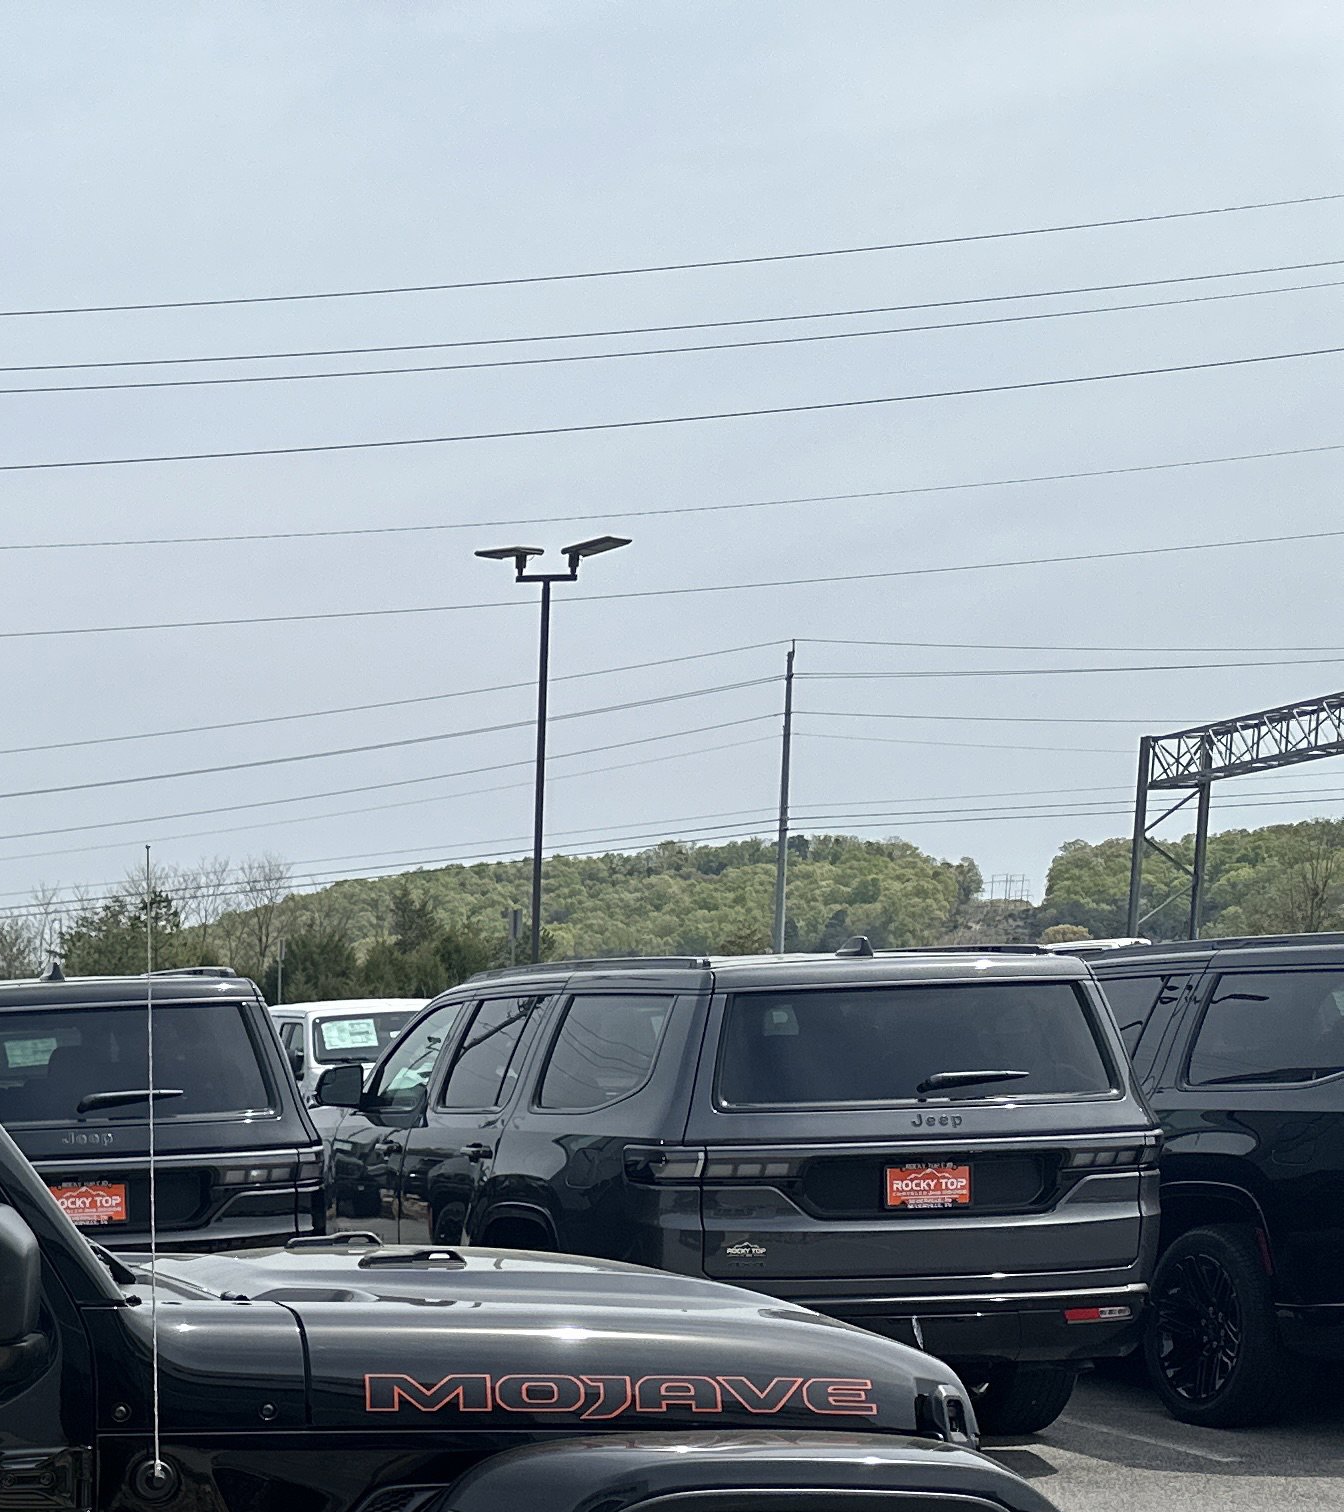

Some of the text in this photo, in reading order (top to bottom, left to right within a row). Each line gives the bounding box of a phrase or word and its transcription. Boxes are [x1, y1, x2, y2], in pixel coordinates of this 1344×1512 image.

[911, 1113, 963, 1128] Jeep
[892, 1178, 967, 1191] ROCKY TOP
[57, 1195, 122, 1209] OCKY TOP
[364, 1373, 878, 1420] MOJAVE
